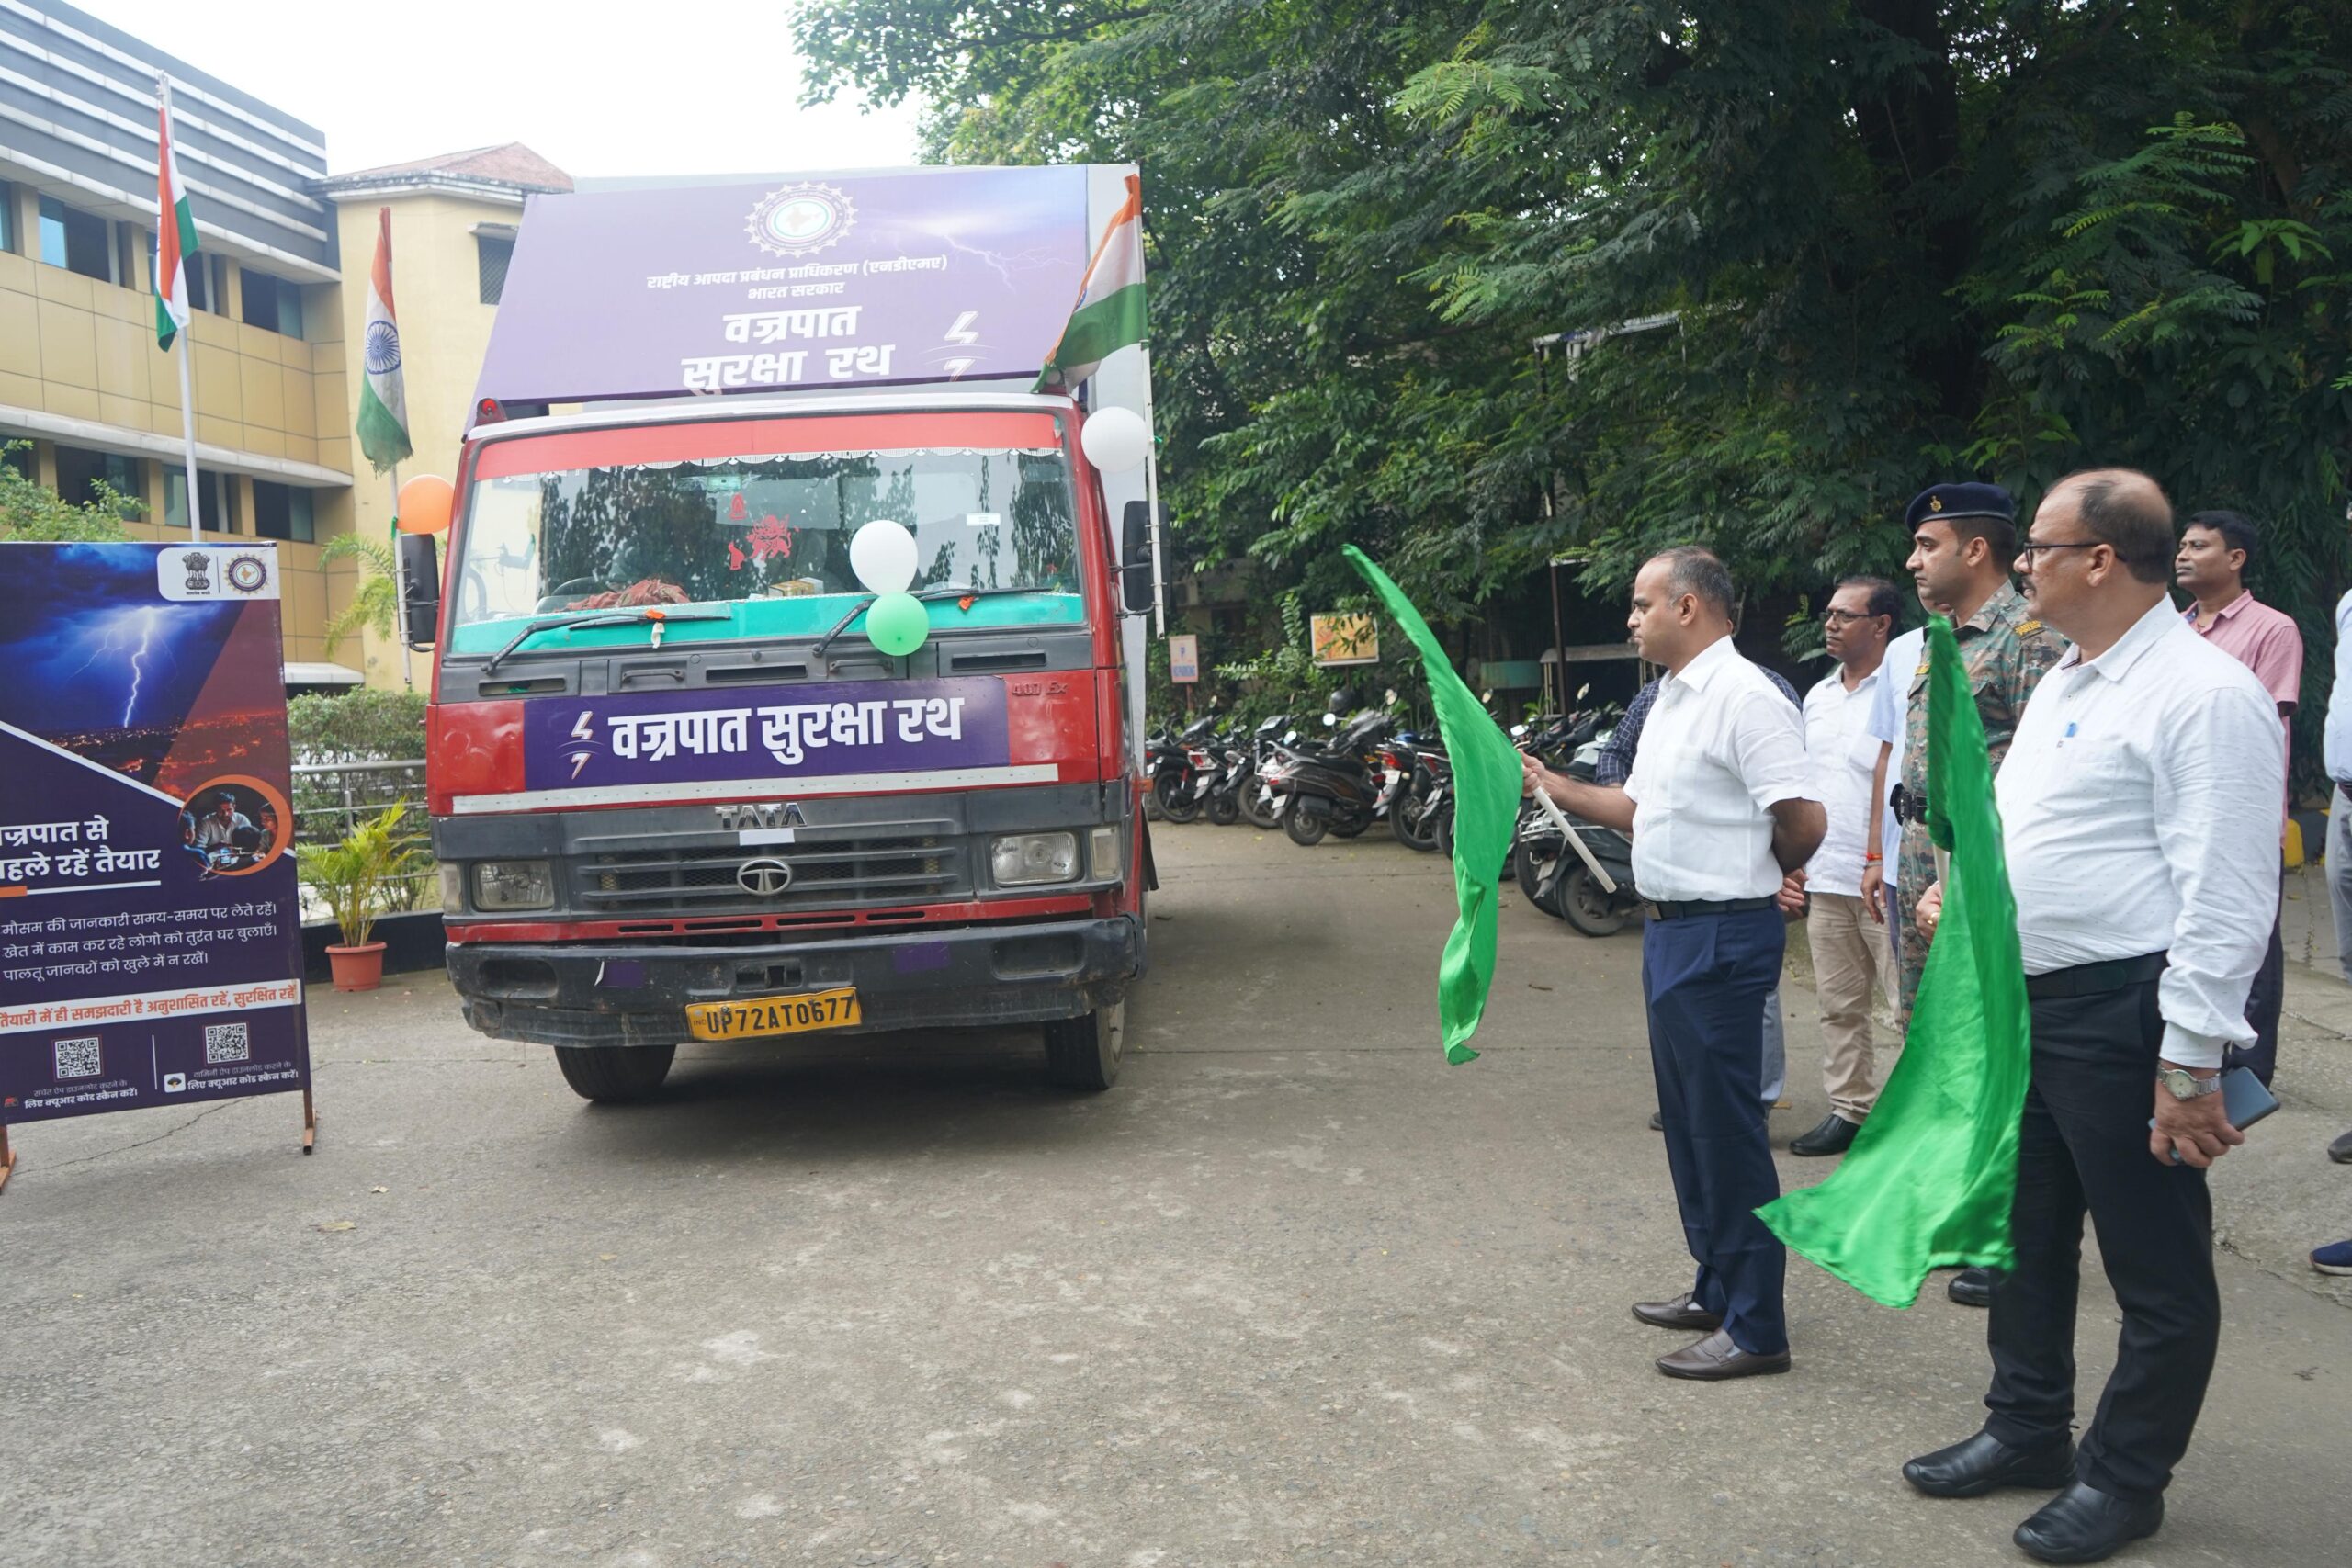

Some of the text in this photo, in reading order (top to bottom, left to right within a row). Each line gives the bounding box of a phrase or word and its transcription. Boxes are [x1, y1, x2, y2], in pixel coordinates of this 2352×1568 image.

[647, 254, 947, 289] राष्ट्रीय आपदा प्रबंधन प्राधिकरण (एनडीएमए)
[748, 282, 845, 299] भारत सरकार
[722, 305, 863, 344] वज्रपात
[680, 344, 896, 395] सुरक्षा रथ
[607, 696, 966, 765] वज्रपात सुरक्षा रथ
[0, 814, 109, 847] ज्रपात से
[715, 802, 808, 830] TATA
[55, 848, 91, 877] रहें
[94, 844, 161, 872] तैयार
[46, 917, 67, 931] की
[69, 911, 130, 931] जानकारी
[132, 908, 208, 926] समय-समय
[210, 907, 228, 919] पर
[231, 903, 254, 917] लेते
[3, 943, 29, 959] खेत
[31, 942, 44, 955] में
[47, 941, 79, 954] काम
[82, 939, 106, 952] कर
[107, 934, 126, 950] रहे
[164, 930, 183, 944] को
[186, 928, 213, 946] तुरंत
[216, 928, 234, 940] घर
[3, 966, 45, 982] पालतू
[45, 960, 98, 977] जानवरों
[100, 957, 120, 972] को
[122, 954, 151, 974] खुले
[153, 953, 165, 967] में
[168, 954, 180, 966] न
[0, 1009, 37, 1027] तैयारी
[39, 1007, 53, 1023] में
[54, 1005, 68, 1021] ही
[71, 999, 132, 1021] समझदारी
[133, 998, 144, 1014] है
[147, 993, 209, 1015] अनुशासित
[233, 987, 277, 1008] सुरक्षित
[278, 985, 297, 999] रहें
[706, 996, 855, 1034] UP72AT0677
[187, 1079, 206, 1090] लिए
[208, 1077, 237, 1090] क्यूआर
[239, 1074, 256, 1085] कोड
[24, 1098, 43, 1109] लिए
[45, 1095, 75, 1108] क्यूआर
[76, 1091, 96, 1102] कोड
